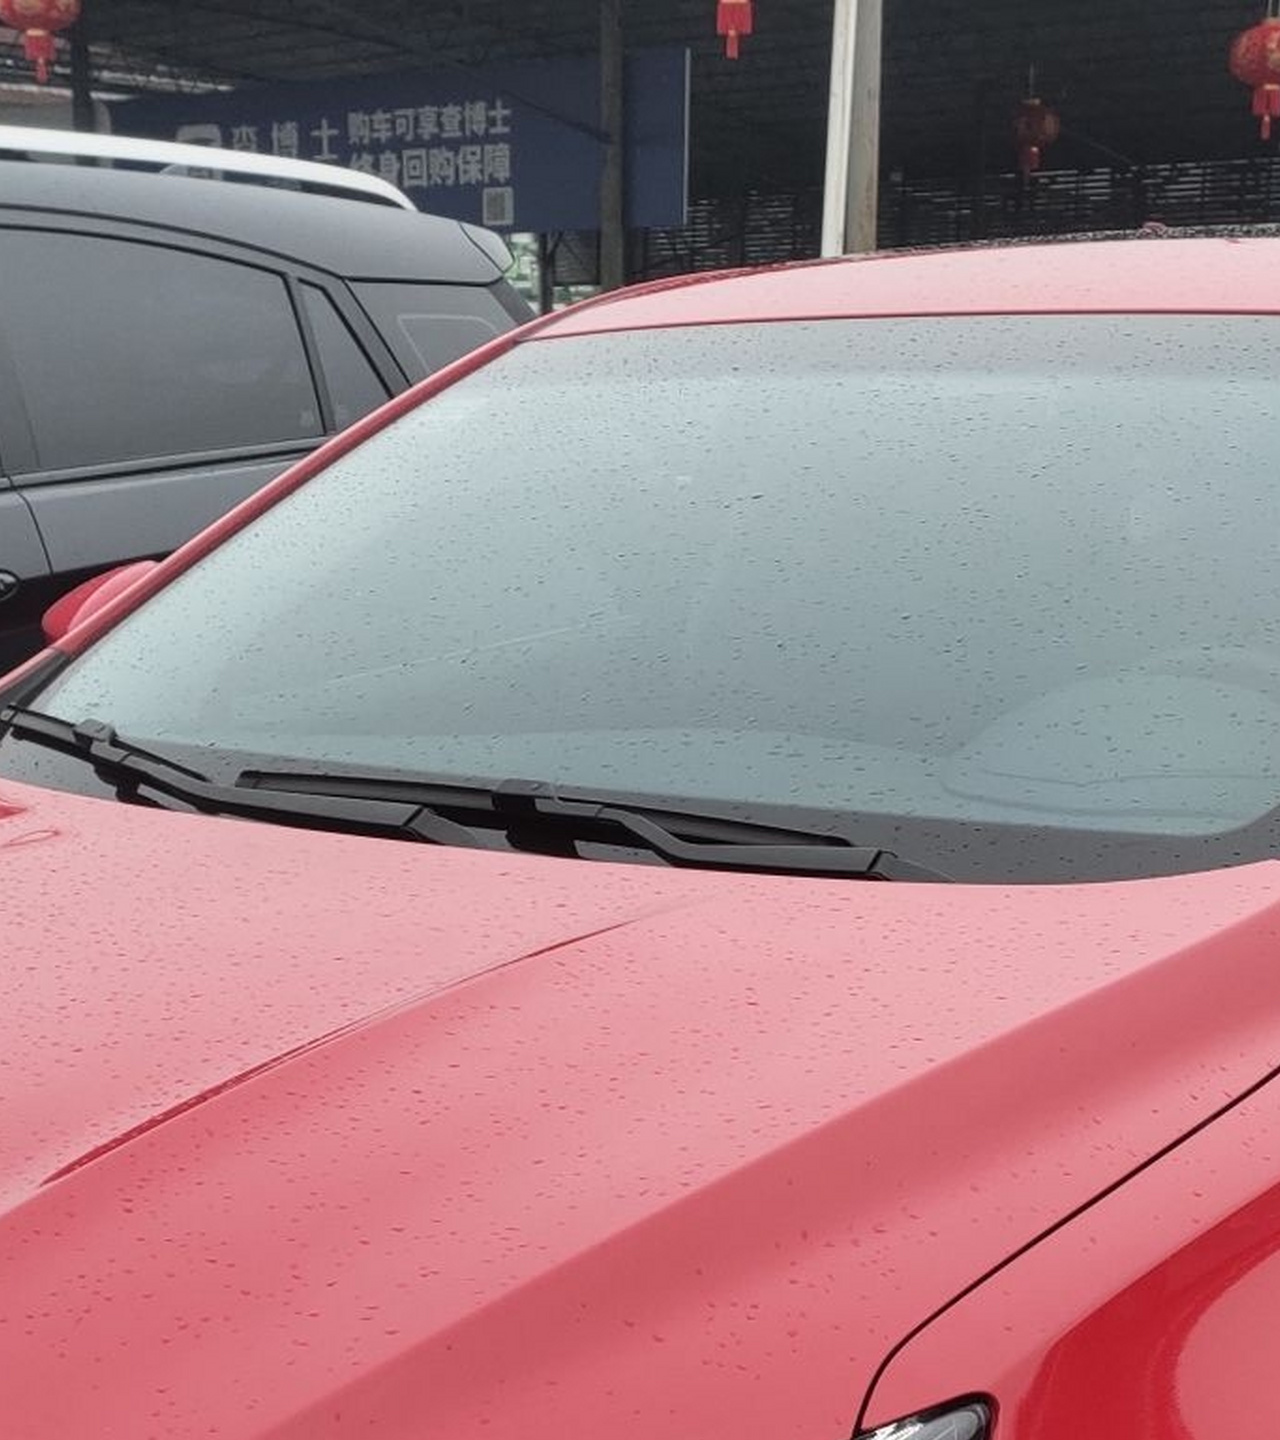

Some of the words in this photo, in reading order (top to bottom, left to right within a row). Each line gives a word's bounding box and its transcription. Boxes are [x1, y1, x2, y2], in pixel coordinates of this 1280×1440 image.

[347, 98, 512, 146] 购车可享查博士
